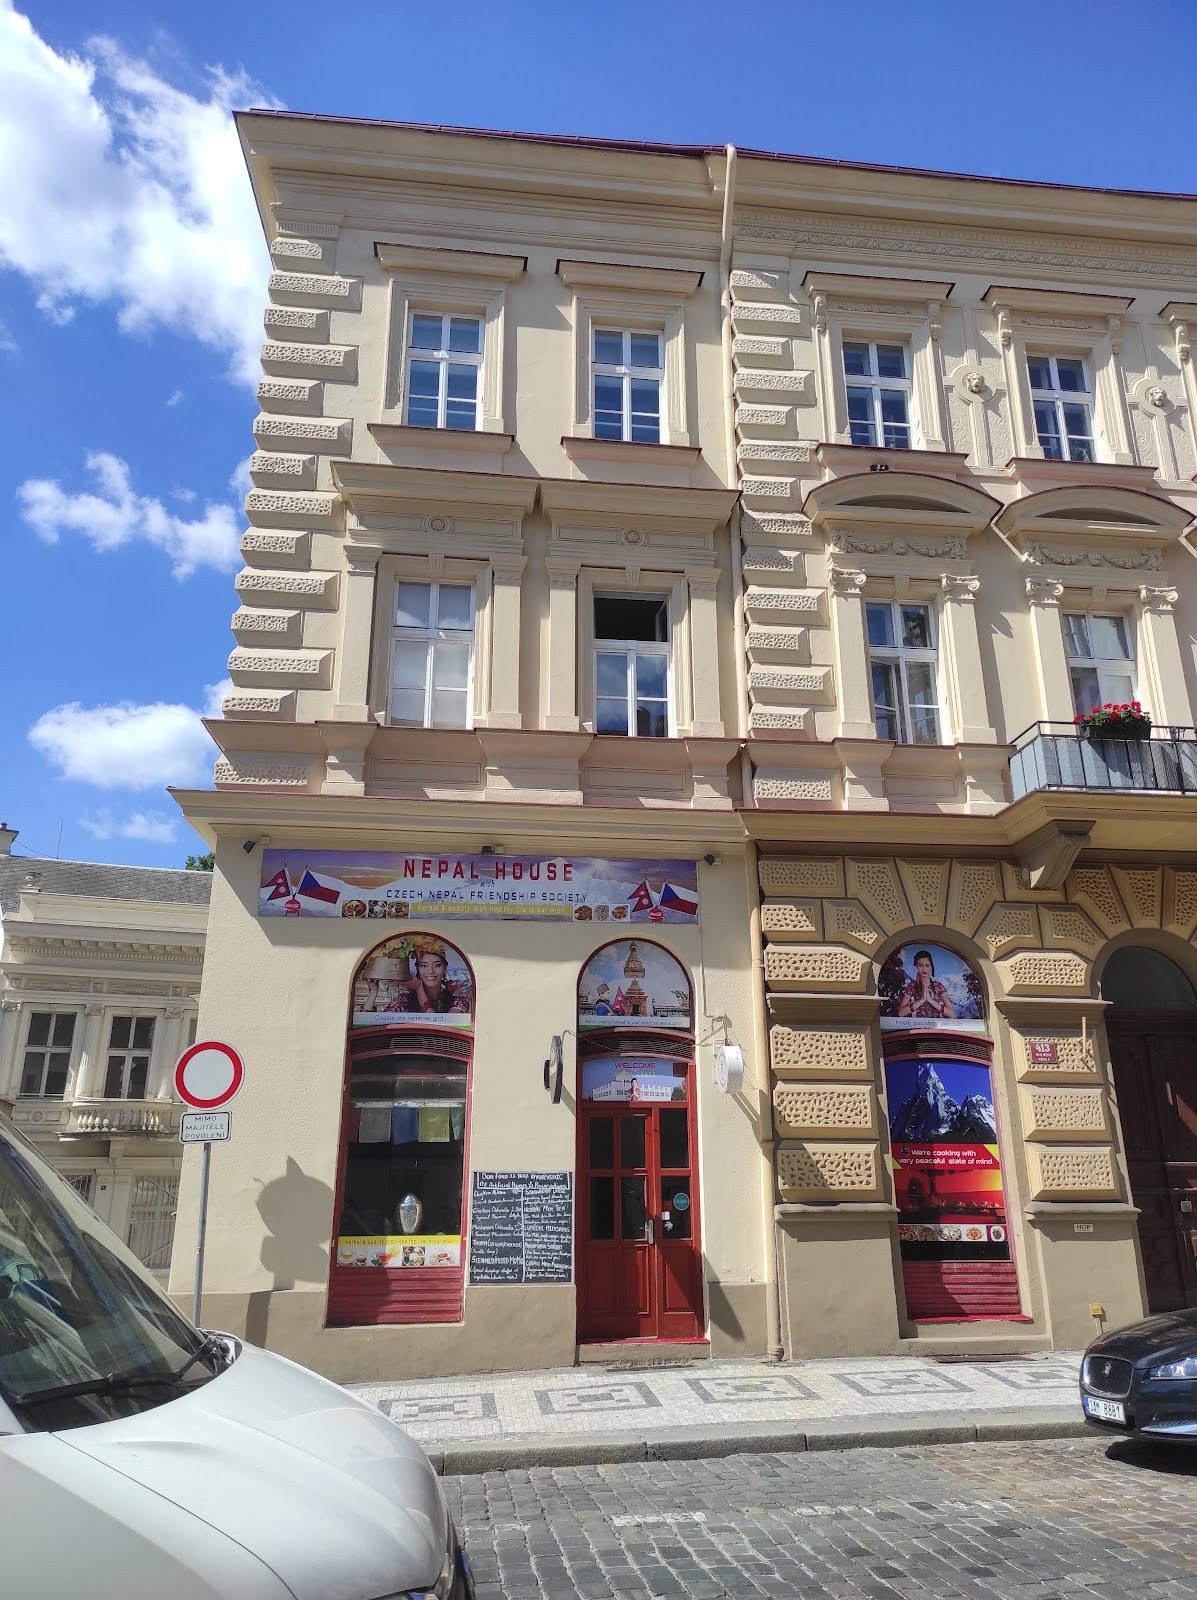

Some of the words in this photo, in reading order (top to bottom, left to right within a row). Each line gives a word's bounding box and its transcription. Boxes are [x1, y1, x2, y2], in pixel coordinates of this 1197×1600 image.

[403, 859, 479, 879] NEPAL
[495, 861, 573, 882] HOUSE
[386, 890, 423, 899] CZECH
[429, 891, 464, 900] NEPAL
[470, 891, 536, 901] FRIENDSHIP
[541, 892, 588, 903] SOCIETY
[1035, 1043, 1051, 1052] 413
[932, 1149, 960, 1157] cooking
[915, 1157, 945, 1165] peaceful
